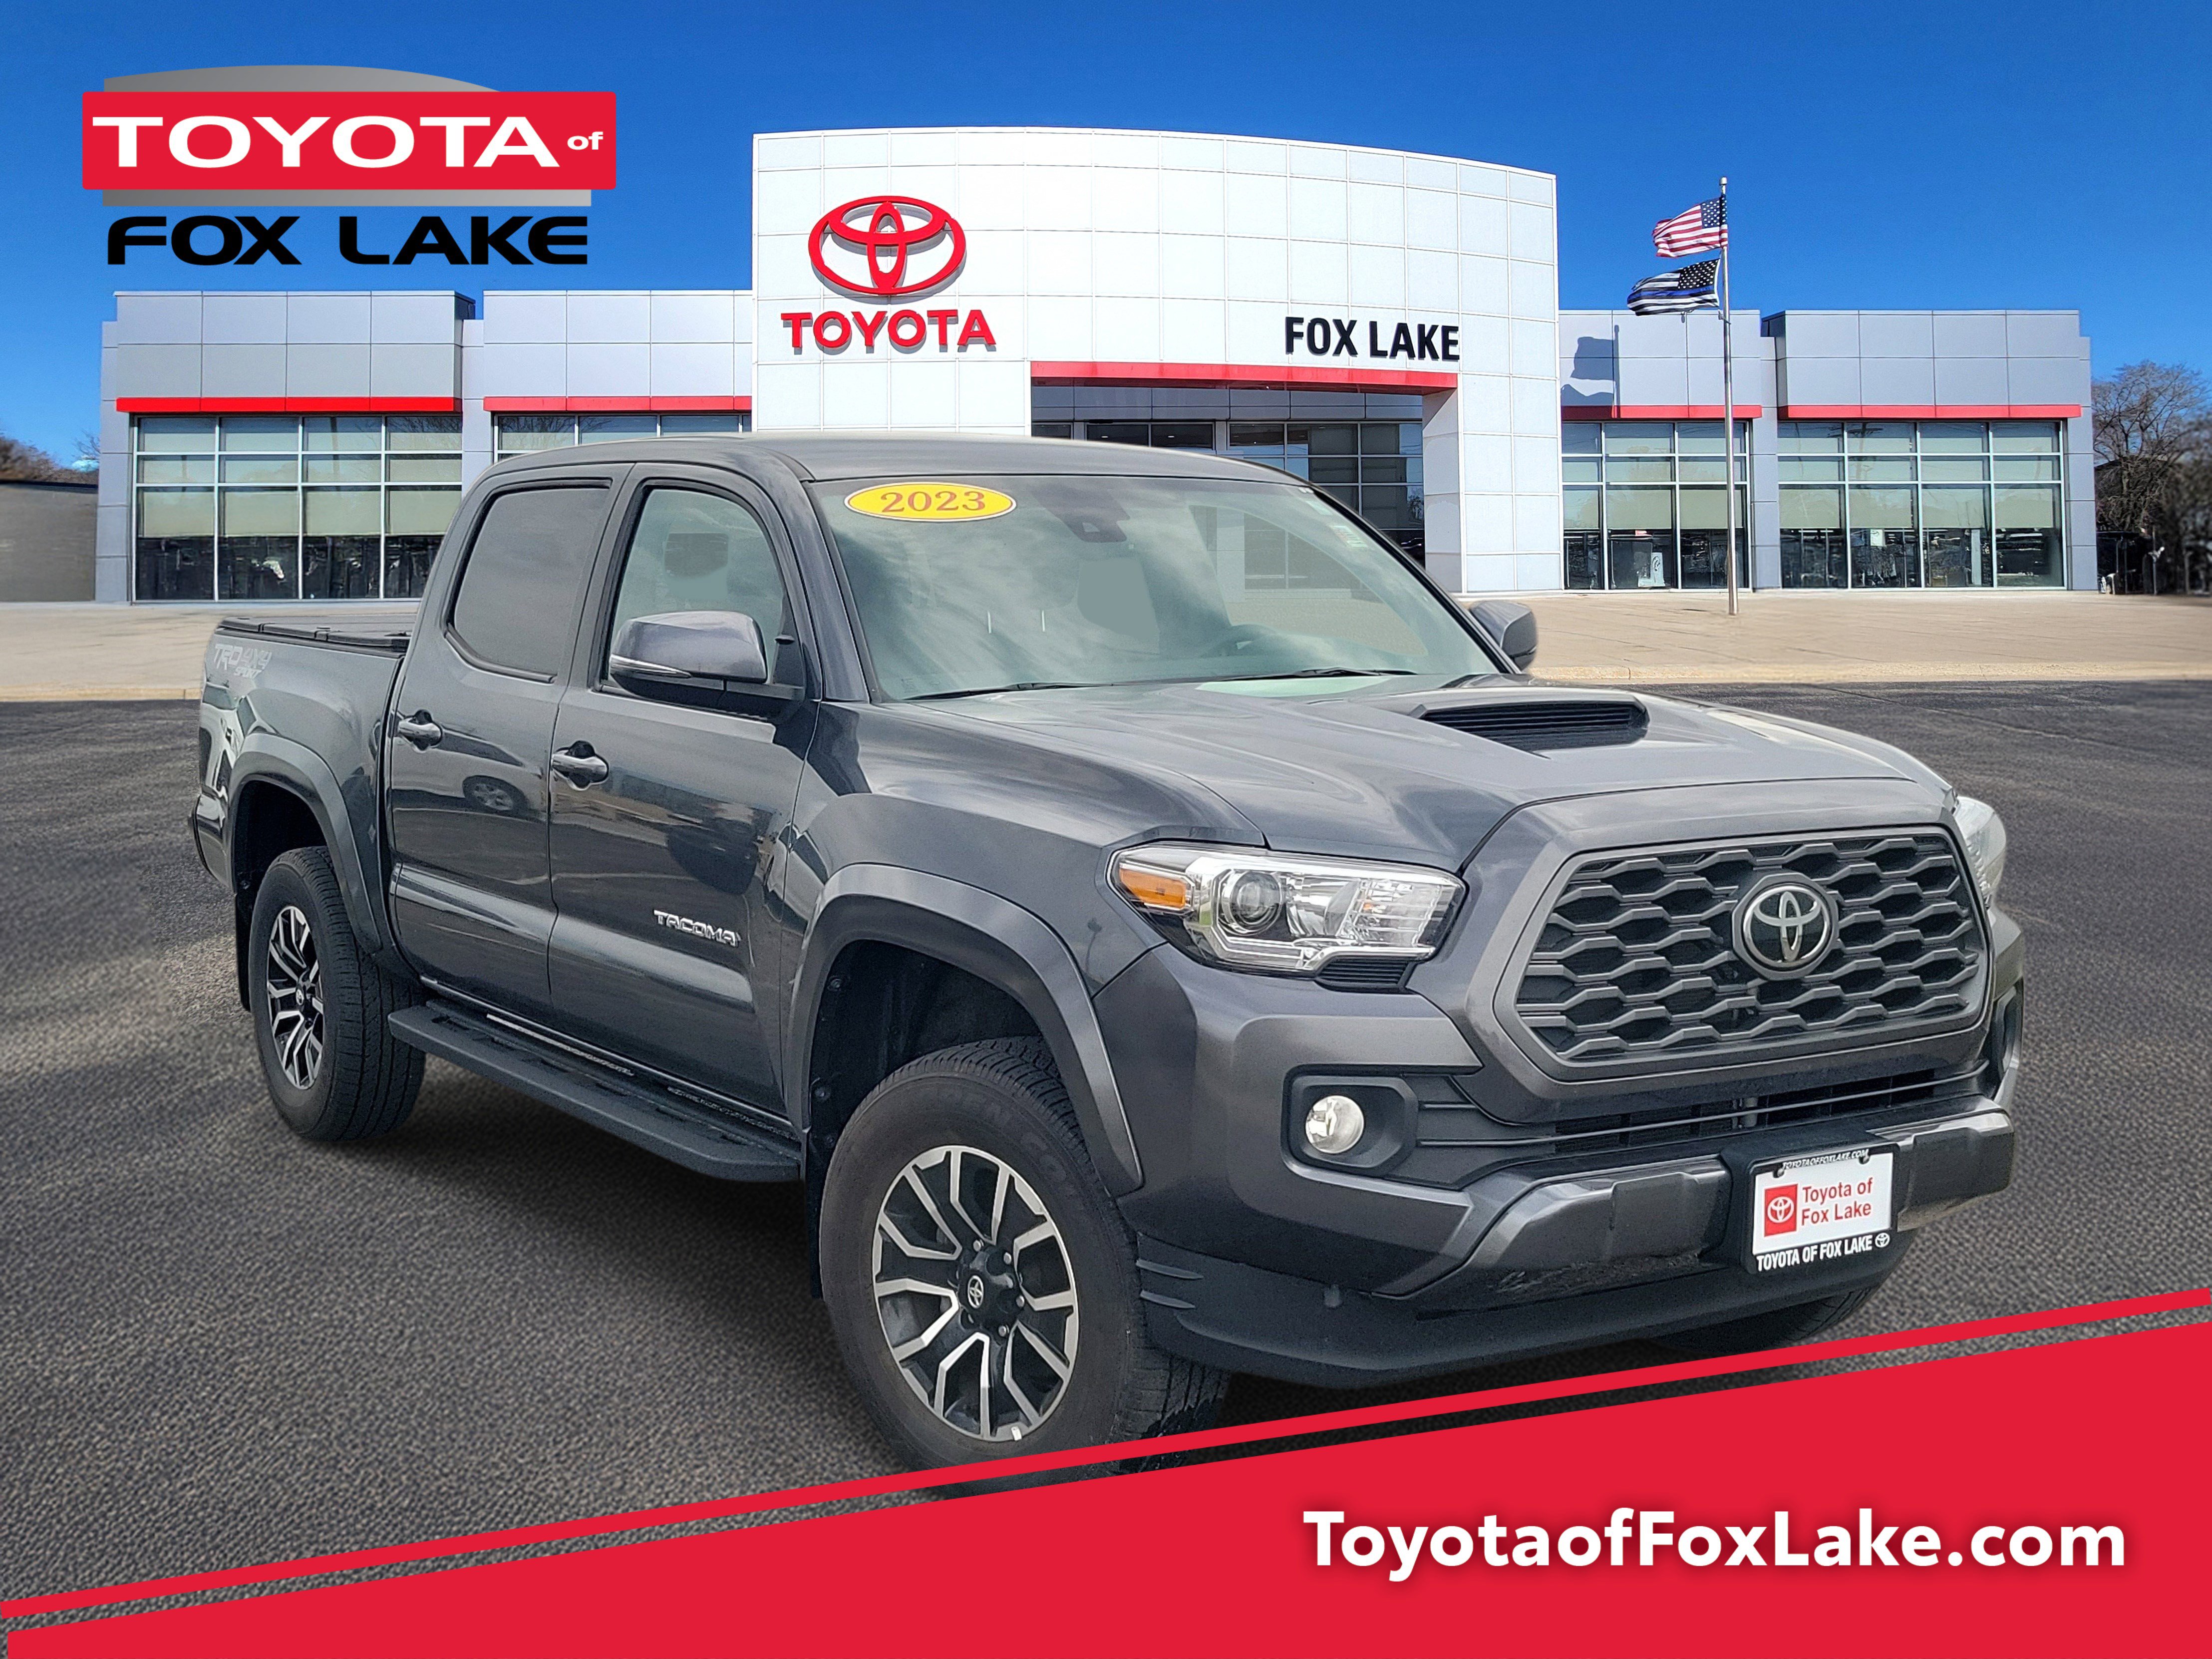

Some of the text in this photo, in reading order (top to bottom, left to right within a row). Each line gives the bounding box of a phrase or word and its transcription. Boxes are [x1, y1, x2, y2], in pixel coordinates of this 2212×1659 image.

[781, 310, 996, 352] TOYOTA
[1285, 317, 1460, 360] FOX LAKE
[881, 491, 985, 512] 2023
[653, 910, 741, 947] TACOMA
[1803, 1177, 1873, 1205] Toyota of
[1802, 1201, 1871, 1226] Fox Lake
[1757, 1235, 1872, 1271] TOYOTA OF FOX LAKE
